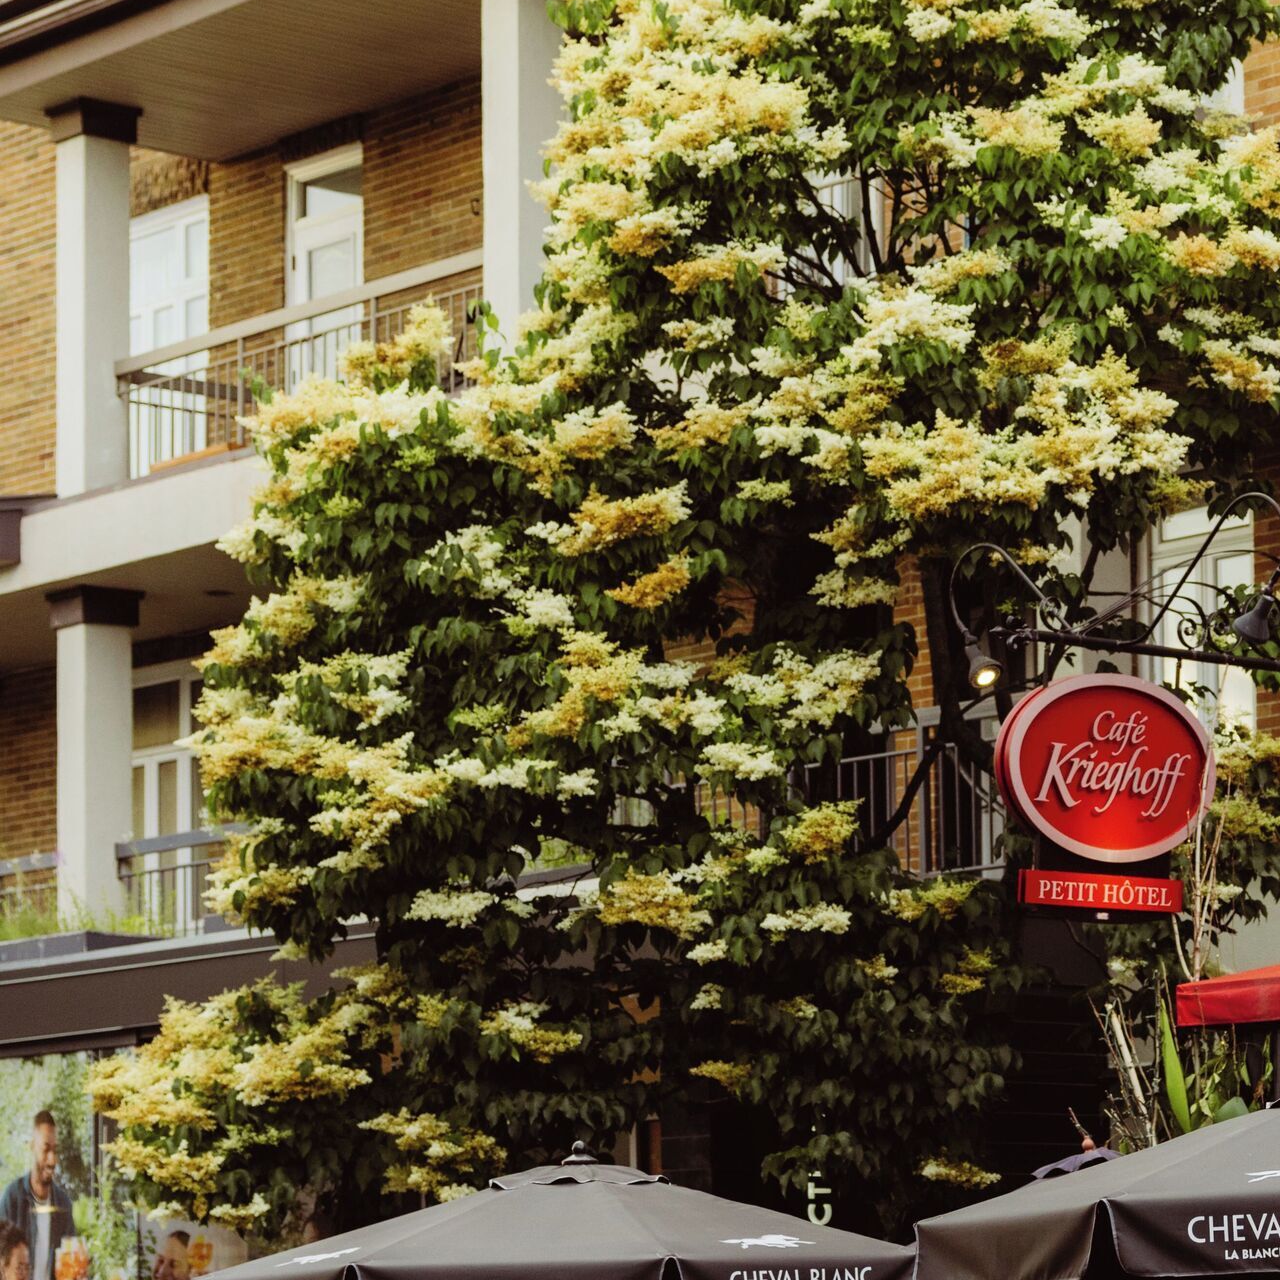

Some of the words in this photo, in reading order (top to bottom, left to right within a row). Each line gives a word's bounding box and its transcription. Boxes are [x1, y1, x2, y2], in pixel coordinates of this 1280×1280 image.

[1092, 710, 1149, 756] Café
[1034, 741, 1191, 818] Krieghoff
[1038, 879, 1098, 902] PETIT
[1103, 879, 1172, 907] HÔTEL
[1225, 1249, 1239, 1260] LA
